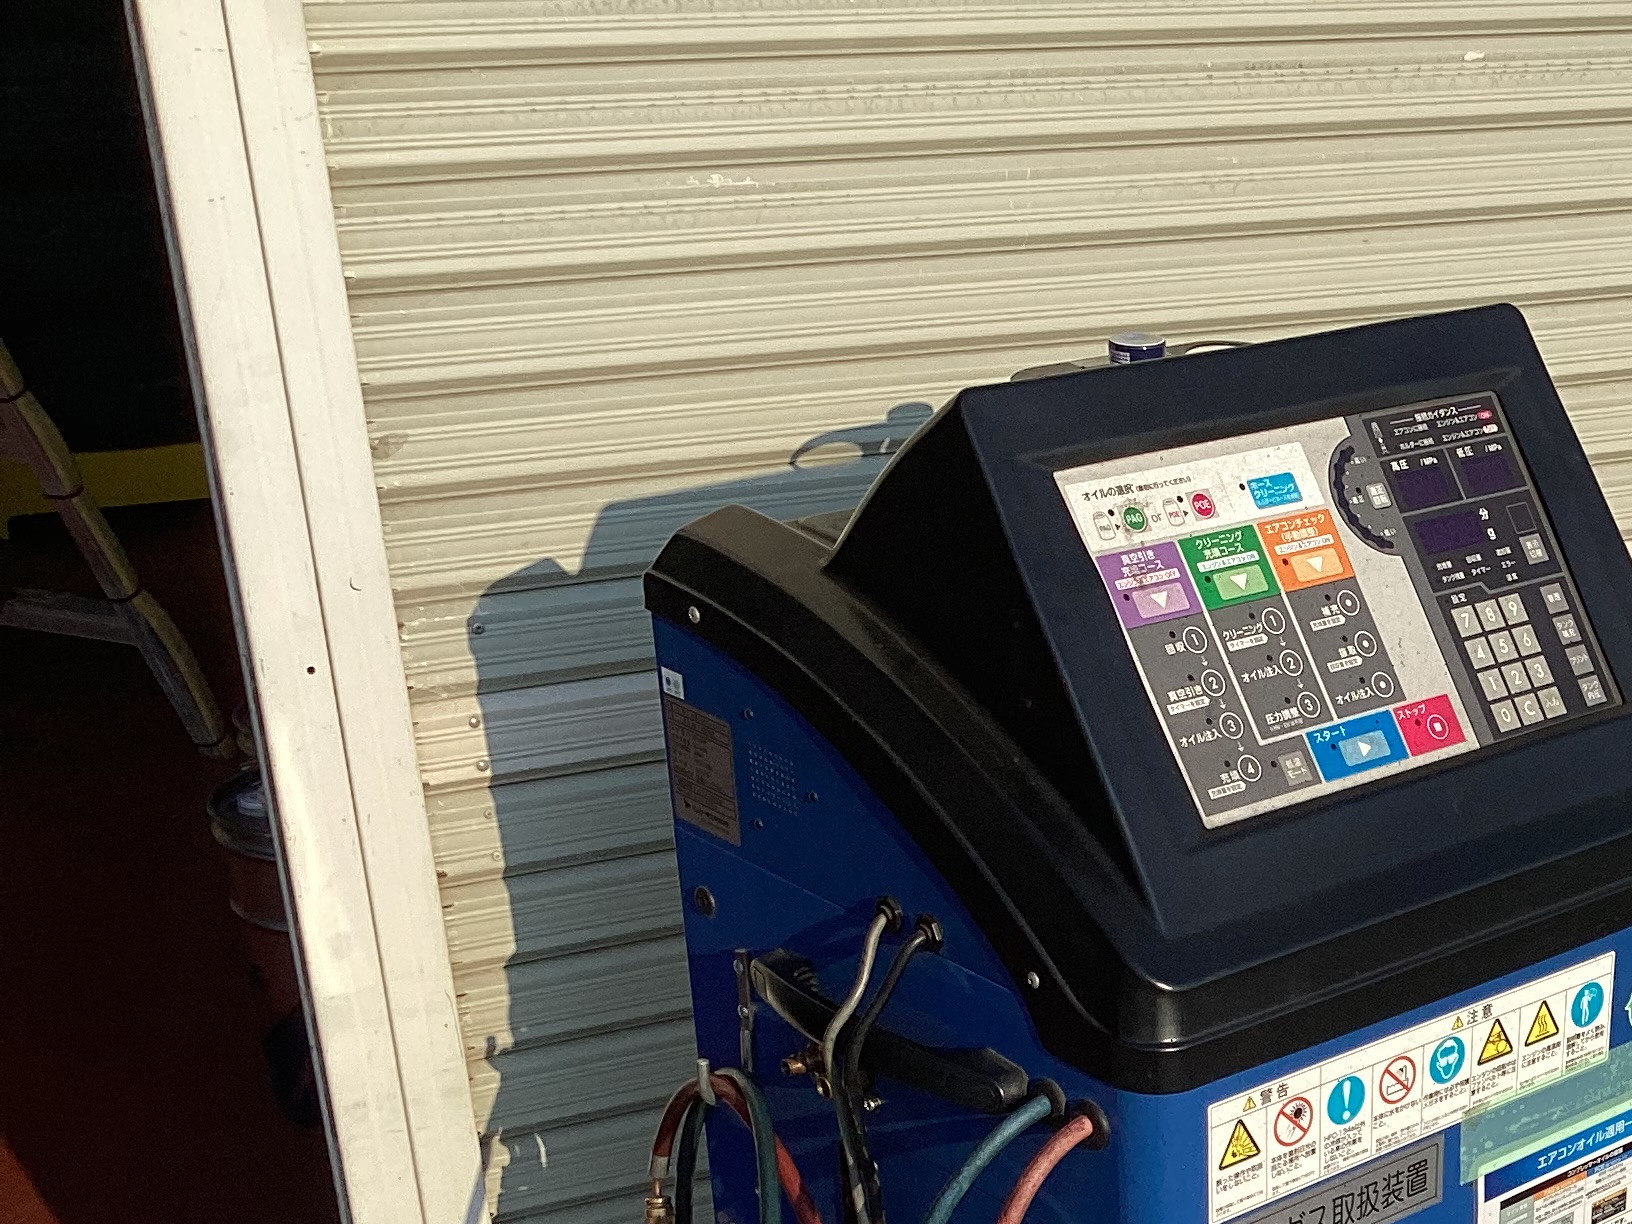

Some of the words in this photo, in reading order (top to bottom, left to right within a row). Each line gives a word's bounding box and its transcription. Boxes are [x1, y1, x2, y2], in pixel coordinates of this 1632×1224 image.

[1081, 483, 1134, 502] オイルの選択
[1253, 483, 1295, 499] クリーニング
[1193, 499, 1212, 510] POE
[1126, 514, 1144, 524] PAG
[1151, 512, 1162, 523] or
[1264, 513, 1325, 535] エアコンチェック
[1195, 531, 1243, 549] クリーニング
[1487, 528, 1496, 540] g
[1461, 612, 1470, 628] 7
[1486, 606, 1496, 622] 8
[1508, 600, 1517, 616] 9
[1222, 622, 1264, 641] クリーニング
[1476, 644, 1486, 660] 4
[1499, 638, 1509, 654] 5
[1523, 632, 1532, 647] 6
[1241, 664, 1283, 683] オイル注入
[1510, 670, 1522, 685] 2
[1536, 663, 1545, 679] 3
[1167, 684, 1203, 702] 真空引き
[1335, 687, 1375, 705] オイル注入
[1397, 704, 1426, 721] ストップ
[1501, 707, 1511, 723] 0
[1524, 700, 1536, 716] C
[1179, 729, 1222, 748] オイル注入
[1313, 726, 1347, 744] スタート
[1466, 1003, 1494, 1026] 注意
[1259, 1082, 1290, 1106] 警告
